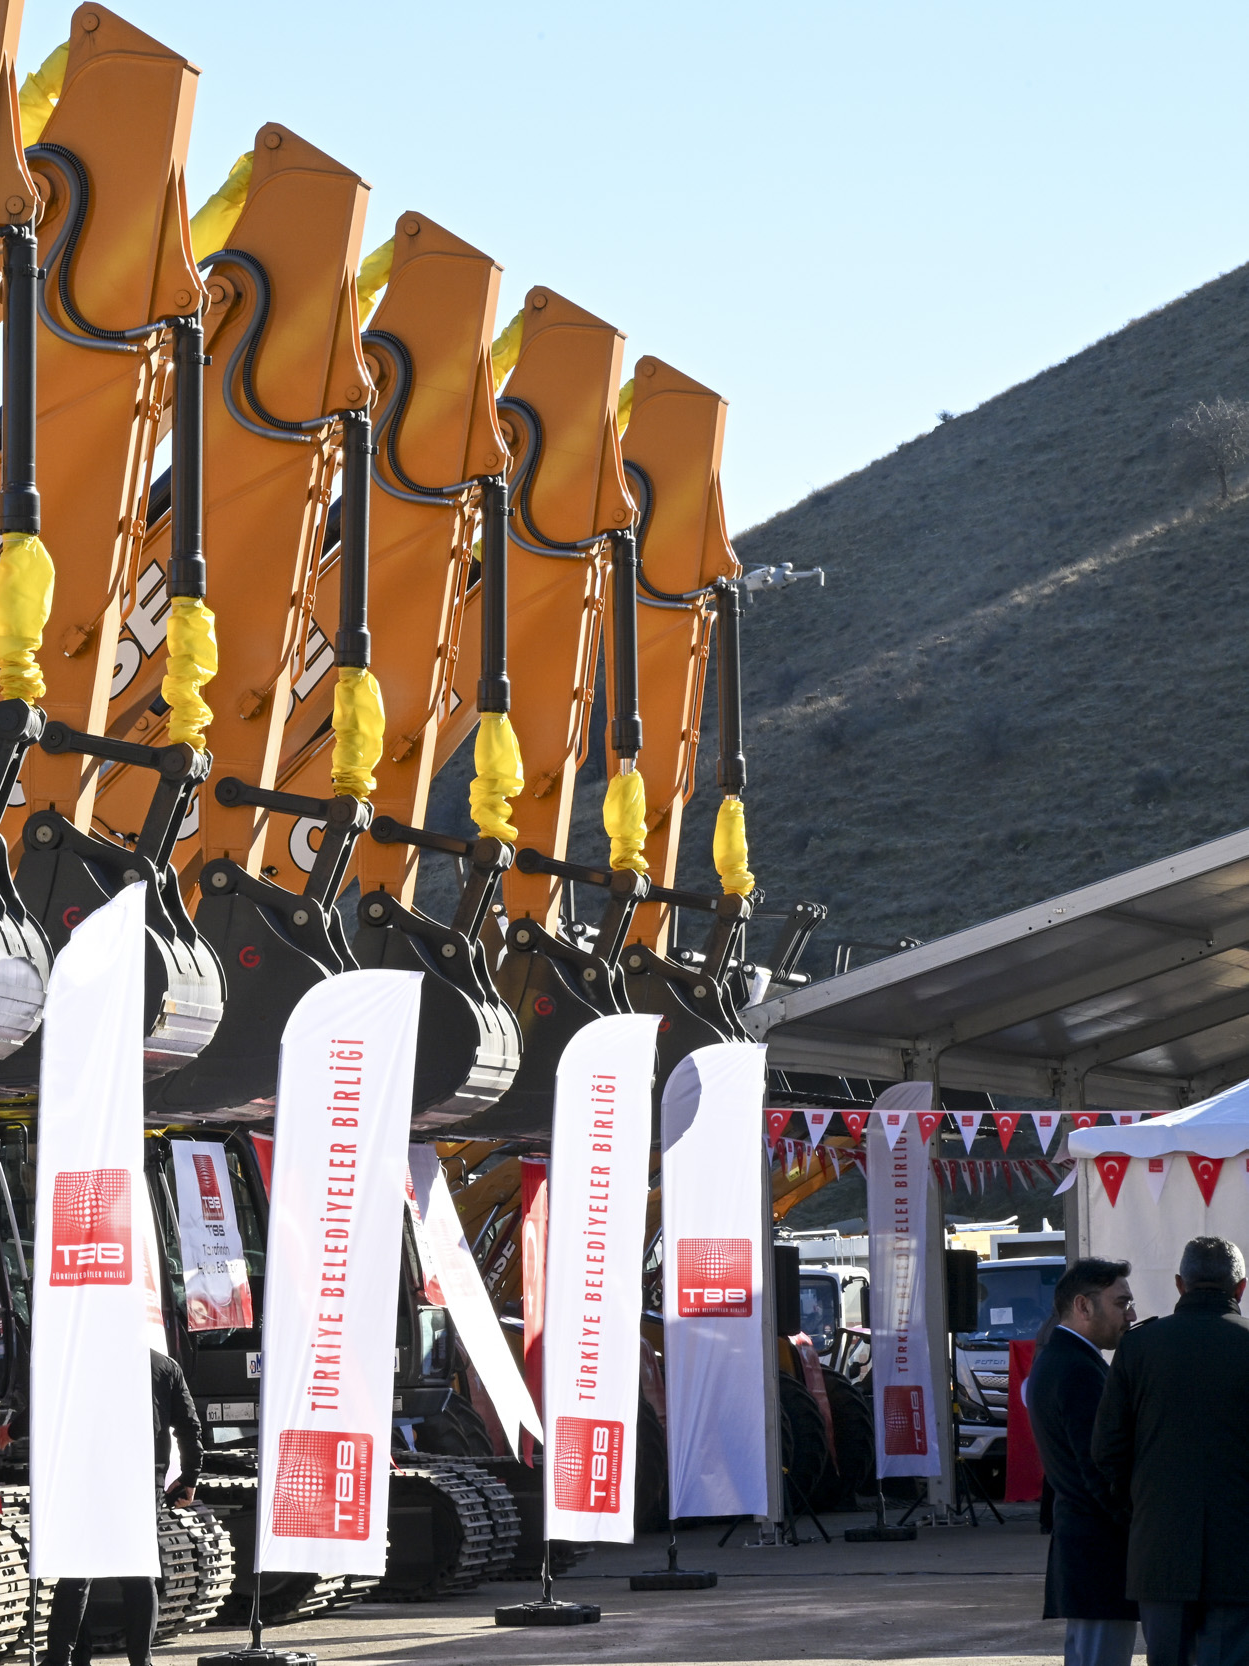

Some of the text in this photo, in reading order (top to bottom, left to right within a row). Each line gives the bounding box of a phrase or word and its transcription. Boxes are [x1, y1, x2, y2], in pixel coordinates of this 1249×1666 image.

[201, 1196, 221, 1208] TBB
[205, 1224, 225, 1236] TBB
[307, 1039, 364, 1411] TÜRKİYE BELEDİYELER BİRLİĞİ
[576, 1074, 616, 1401] TÜRKİYE BELEDİYELER BİRLİĞİ
[104, 1270, 125, 1279] BİRLİĞİ
[682, 1288, 747, 1303] TBB
[895, 1308, 910, 1373] TÜRKİYE
[910, 1391, 921, 1450] TBB
[334, 1440, 355, 1532] TBB
[590, 1427, 609, 1507] TBB
